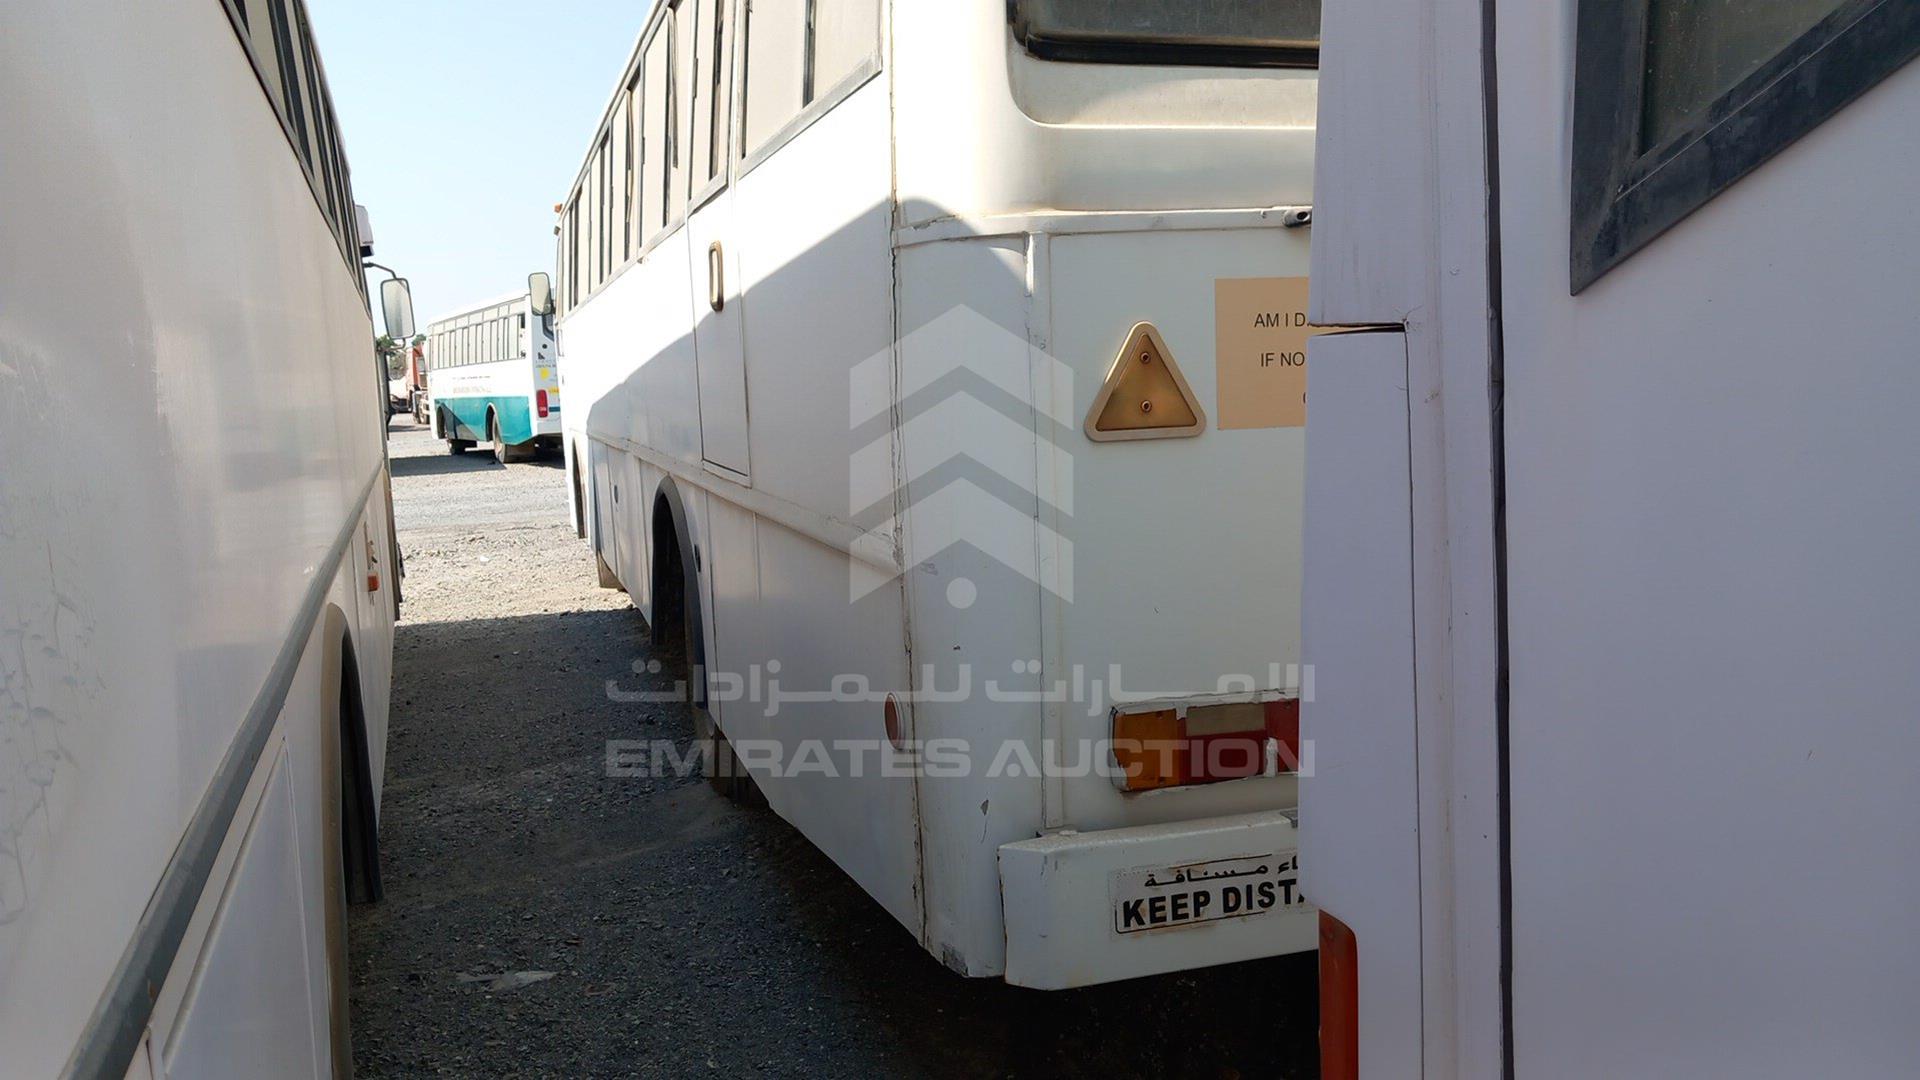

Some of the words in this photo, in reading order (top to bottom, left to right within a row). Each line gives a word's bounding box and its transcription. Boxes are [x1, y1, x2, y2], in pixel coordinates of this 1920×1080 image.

[1254, 312, 1280, 328] AM
[1260, 352, 1275, 368] IF
[1123, 890, 1210, 927] KEEP
[1222, 878, 1305, 913] DIST
